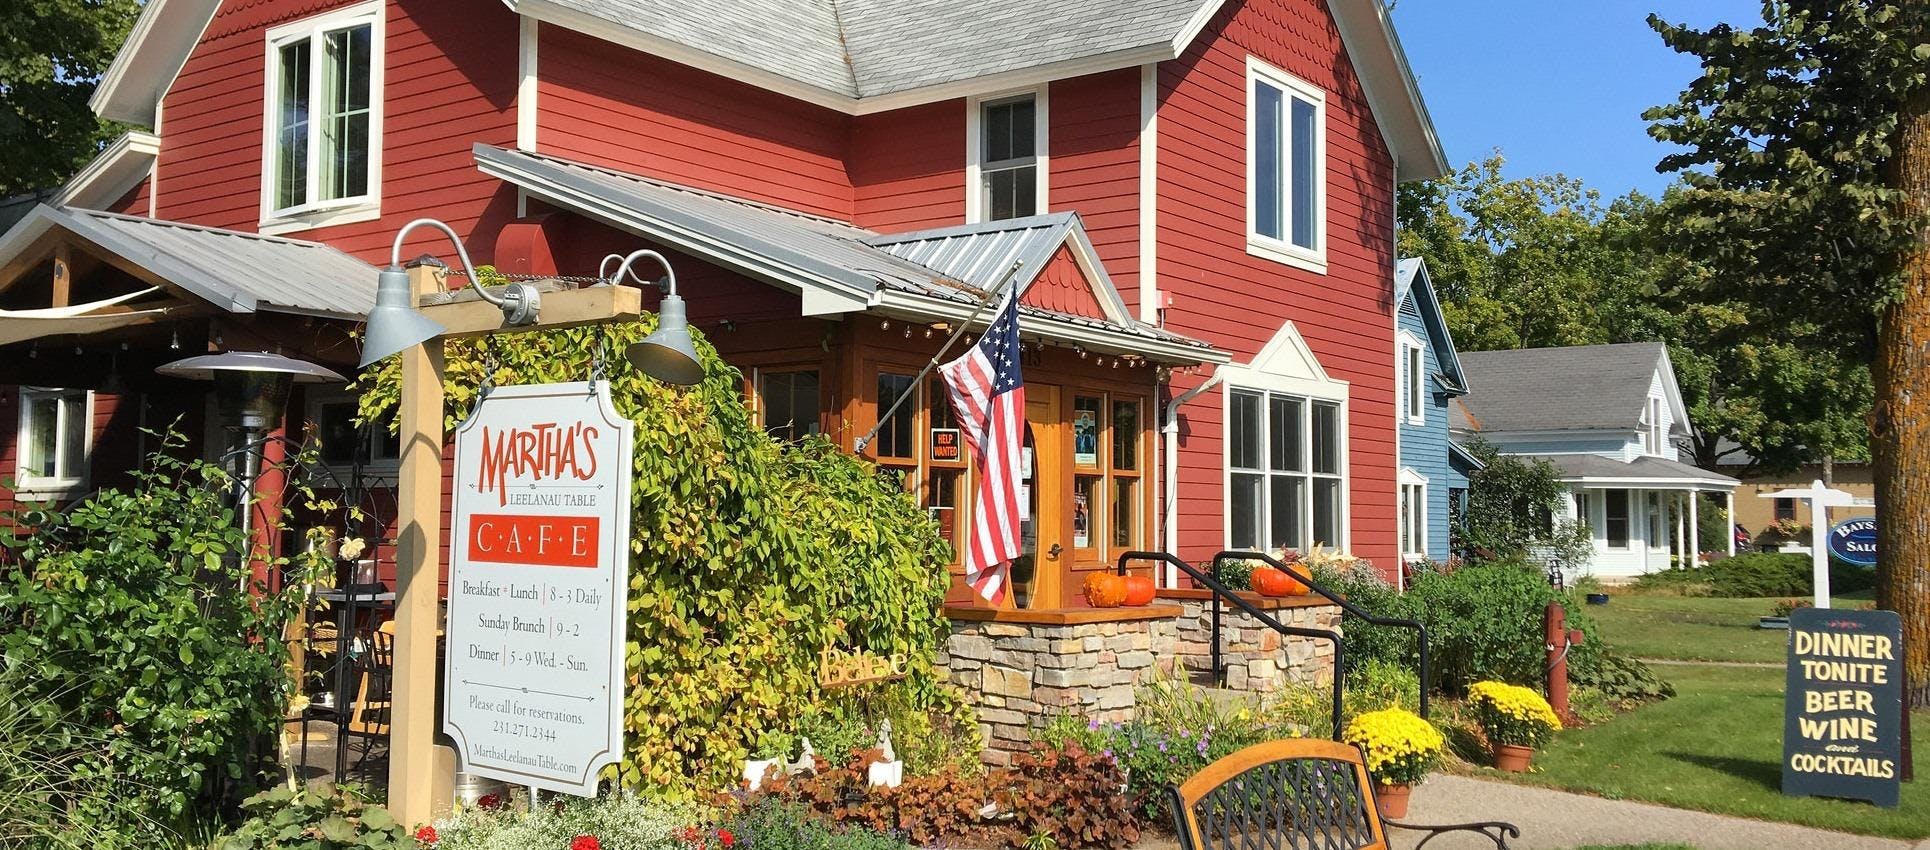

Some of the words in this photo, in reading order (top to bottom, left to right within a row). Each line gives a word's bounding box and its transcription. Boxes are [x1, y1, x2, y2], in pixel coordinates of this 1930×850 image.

[934, 445, 957, 457] WANTED
[937, 433, 953, 445] HELP
[478, 420, 599, 507] MARTHA'S
[510, 494, 560, 506] LEELANAU
[564, 494, 596, 507] TABLE
[462, 580, 500, 597] Breakfast
[510, 583, 538, 600] Lunch
[550, 586, 556, 601] 8
[567, 590, 572, 604] 3
[575, 588, 602, 611] Daily
[478, 613, 510, 636] Sunday
[512, 616, 545, 634] Brunch
[556, 622, 563, 637] 9
[573, 623, 580, 637] 2
[469, 643, 499, 662] Dinner
[510, 650, 515, 664] 5
[525, 652, 531, 666] 9
[534, 651, 556, 669] Wed.
[566, 655, 588, 672] Sun.
[1795, 630, 1895, 661] DINNER
[1800, 660, 1888, 685] TONITE
[469, 695, 494, 712] Please
[496, 697, 511, 714] call
[513, 700, 526, 716] for
[529, 705, 585, 725] reservations.
[1805, 690, 1877, 715] BEER
[493, 720, 557, 743] 231.271.2344
[1799, 716, 1878, 743] WINE
[474, 743, 577, 774] MarthasLeelanauTable.com
[1825, 744, 1860, 753] and
[1790, 753, 1895, 780] COCKTAILS
